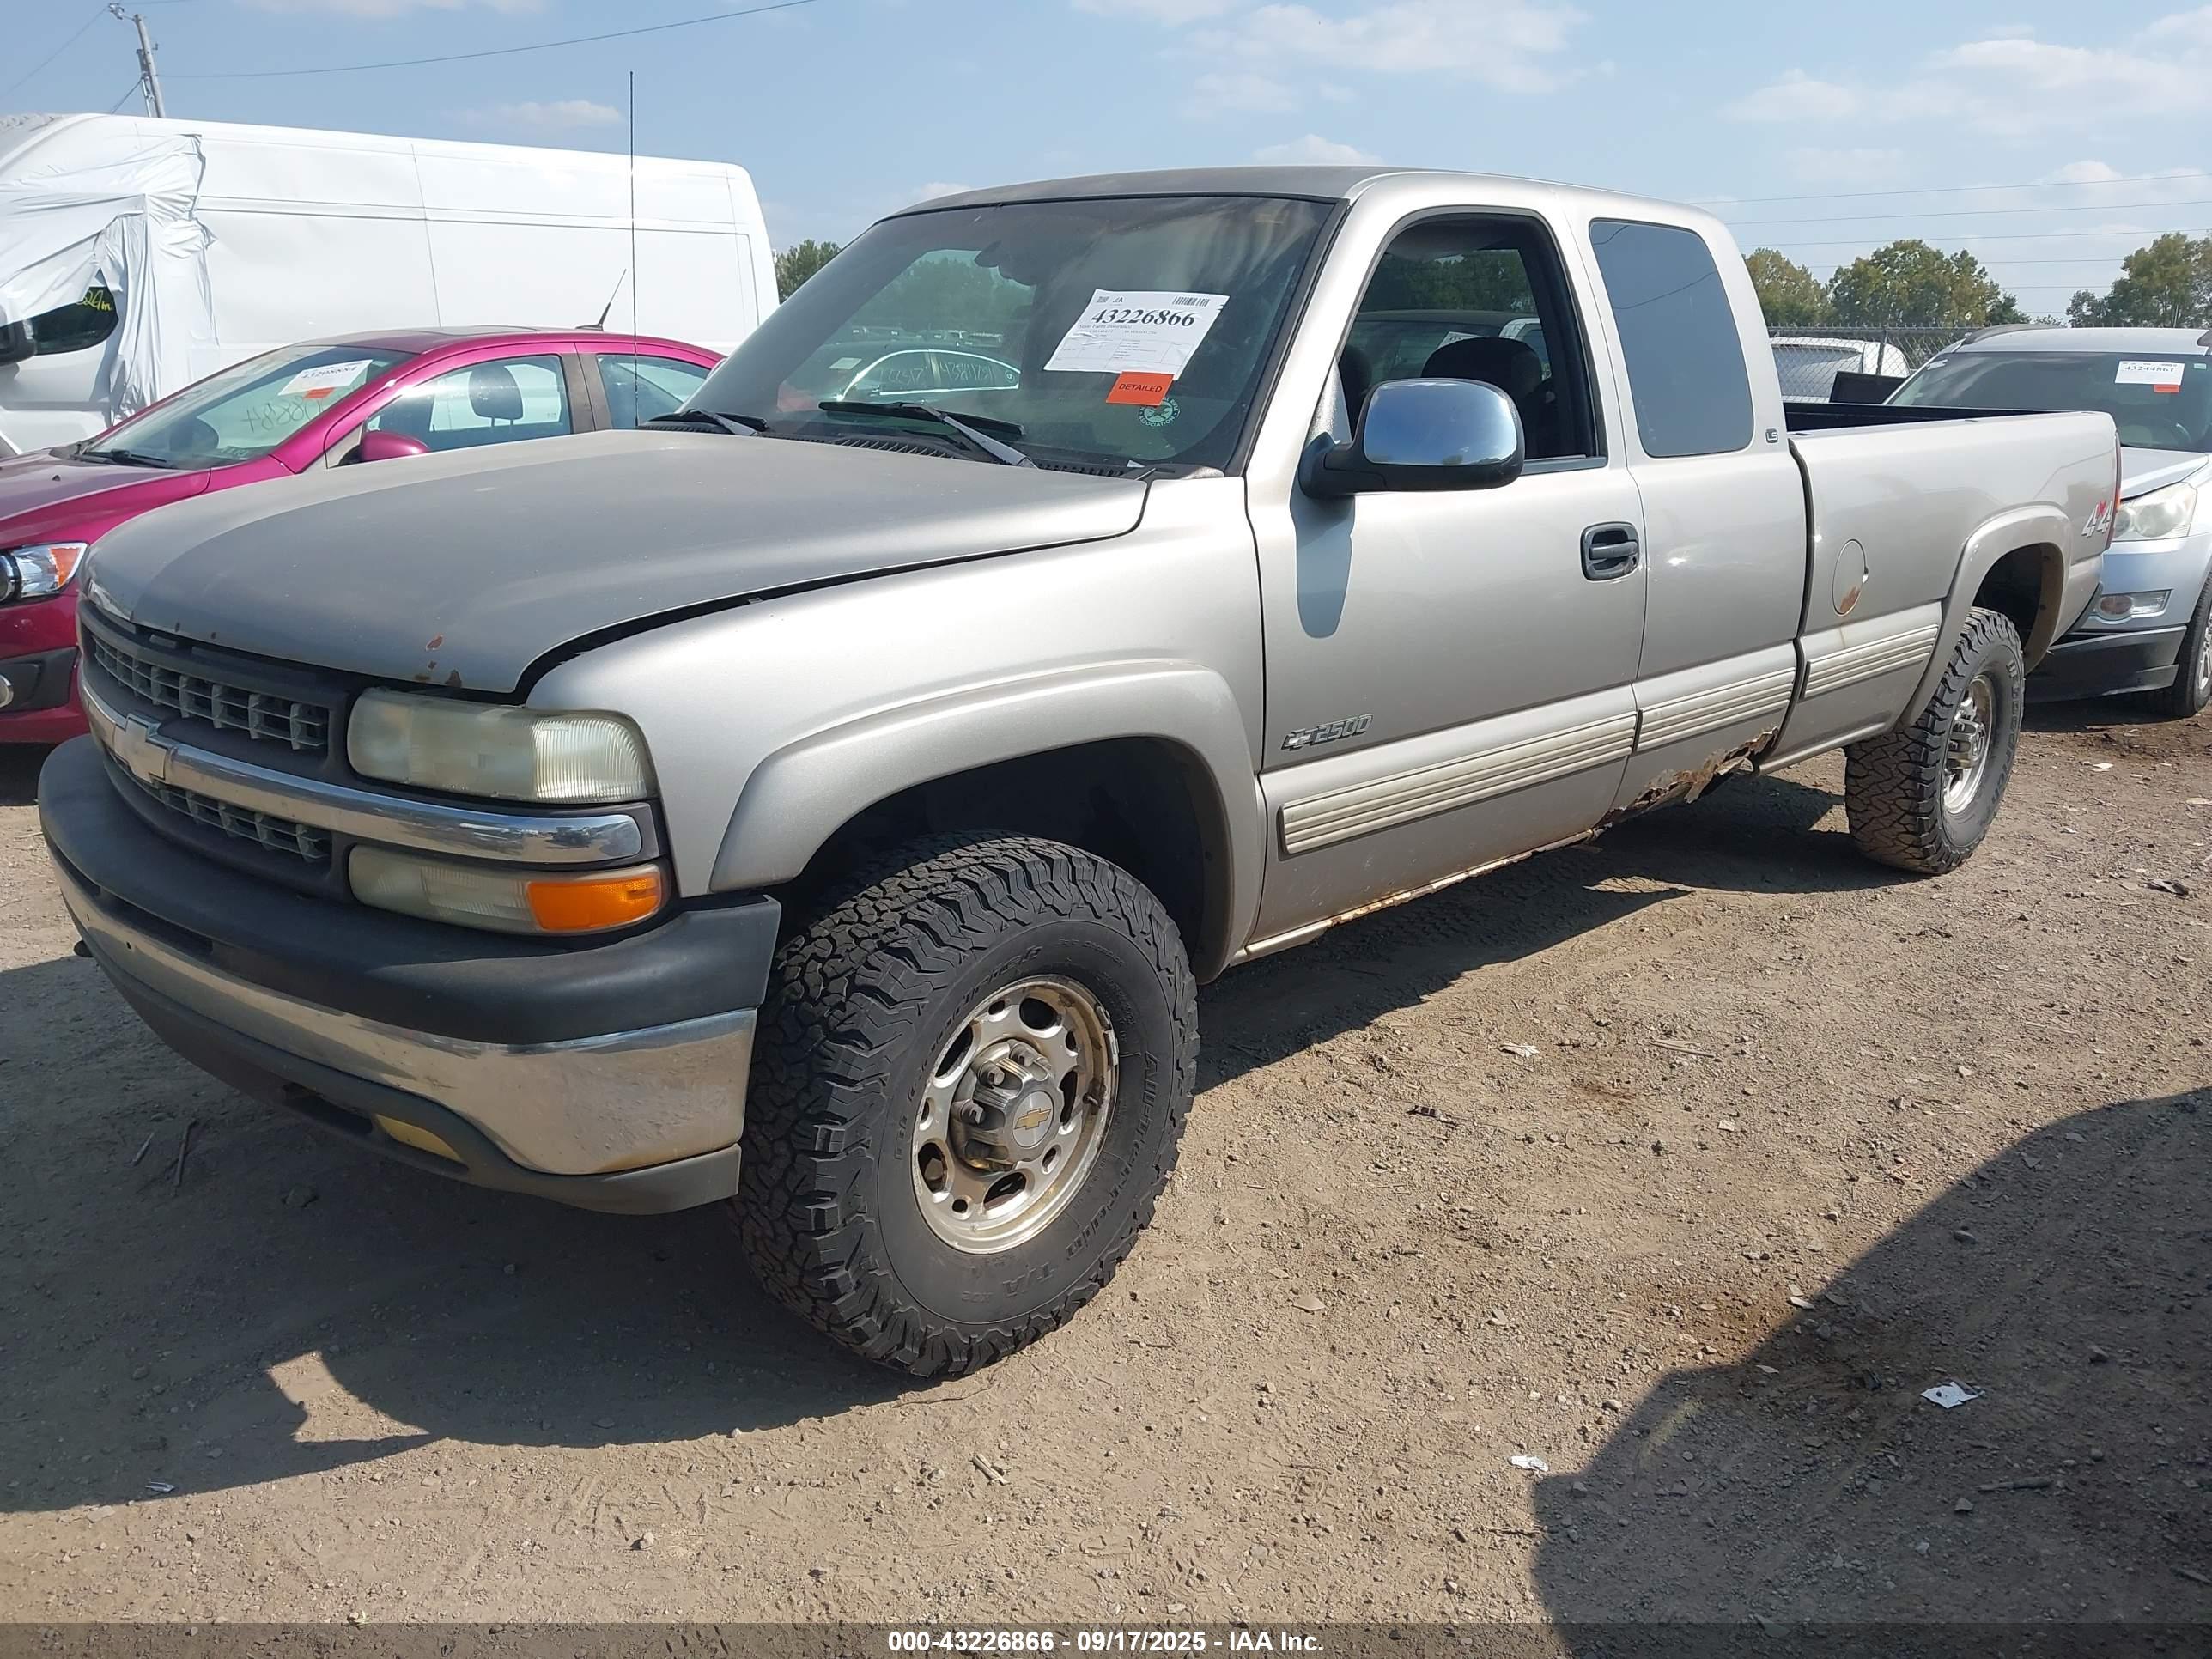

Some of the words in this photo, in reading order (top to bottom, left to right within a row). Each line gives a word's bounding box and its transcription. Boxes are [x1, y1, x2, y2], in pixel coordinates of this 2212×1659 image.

[1091, 308, 1200, 326] 43226866
[1118, 382, 1163, 393] DETAILED
[1766, 431, 1778, 441] LS
[1314, 714, 1372, 743] 2500
